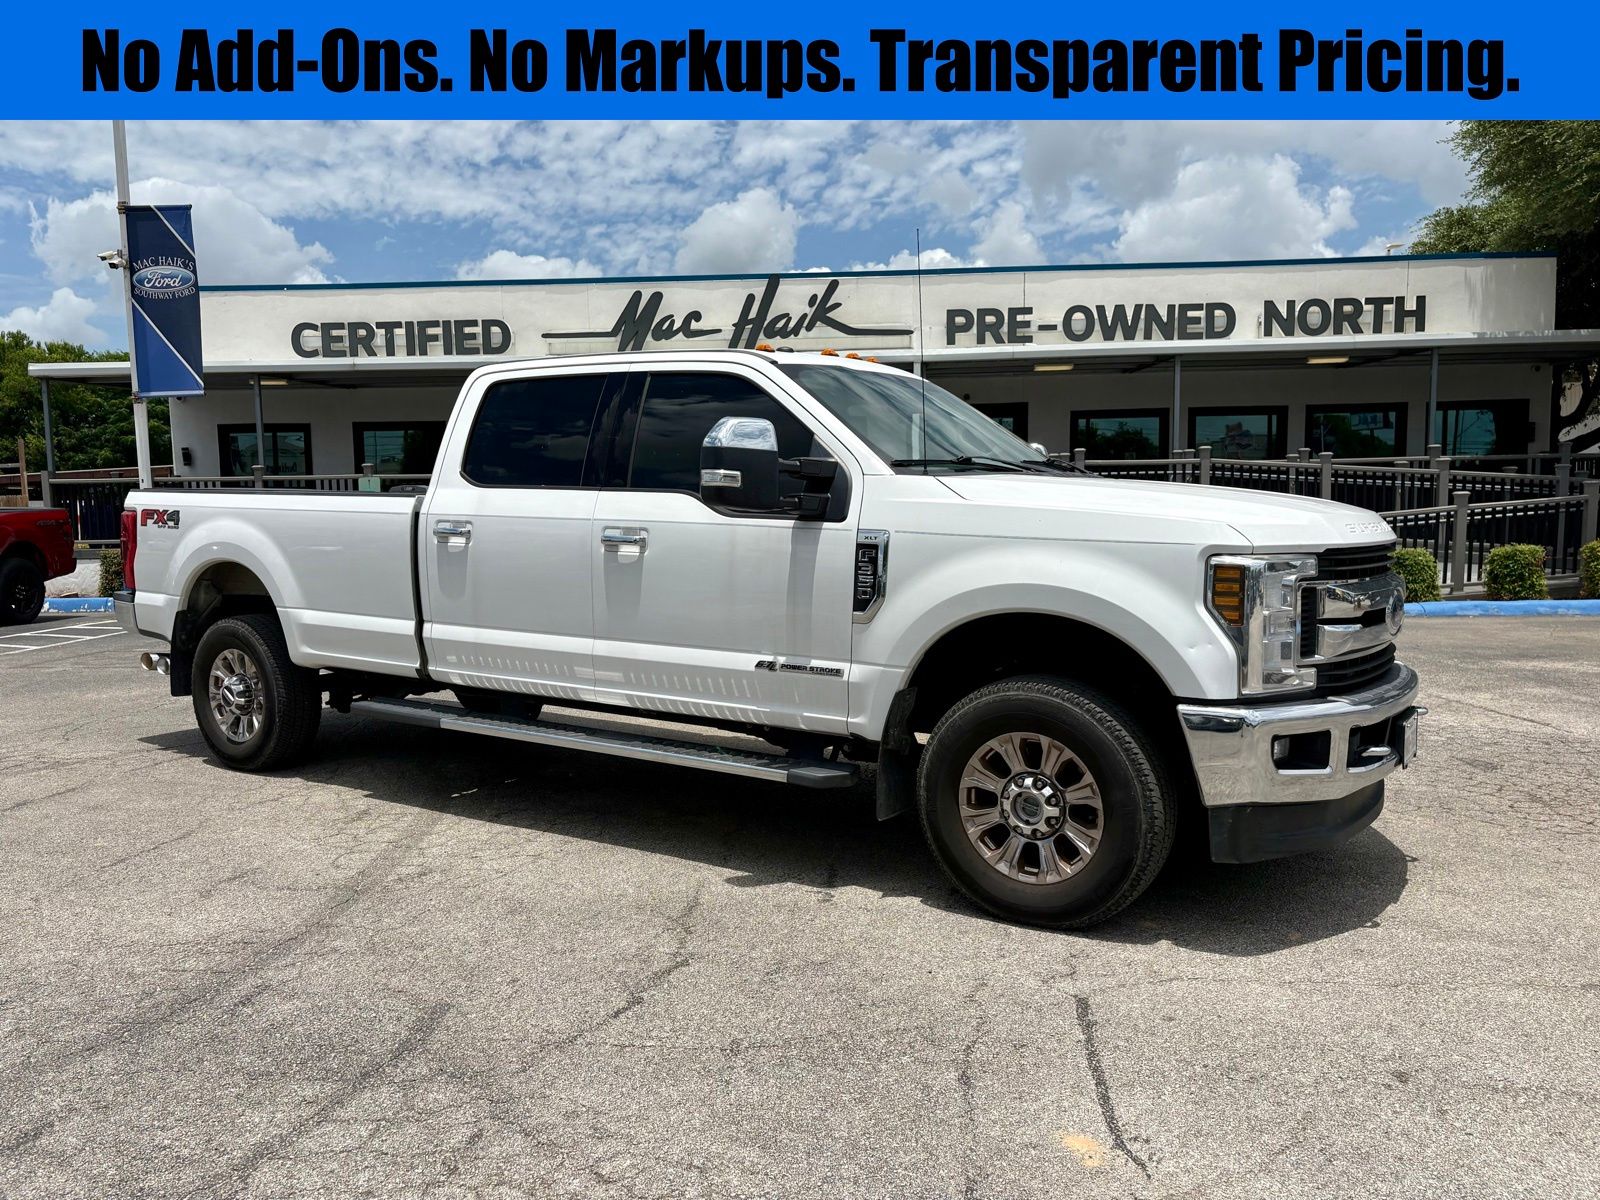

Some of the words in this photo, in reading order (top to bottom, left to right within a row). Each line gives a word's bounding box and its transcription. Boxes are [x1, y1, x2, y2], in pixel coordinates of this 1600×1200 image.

[133, 257, 156, 271] MAC
[159, 256, 195, 271] HAIK'S
[144, 269, 183, 288] Ford
[133, 287, 174, 300] SOUTHWAY
[174, 286, 196, 298] FORD
[541, 290, 722, 352] Mac
[728, 273, 914, 350] Haik
[946, 301, 1237, 347] PRE-OWNED
[1262, 295, 1427, 338] NORTH
[291, 318, 511, 358] CERTIFIED
[140, 508, 181, 527] FX4
[780, 663, 808, 672] POWER
[809, 666, 842, 675] STROKE
